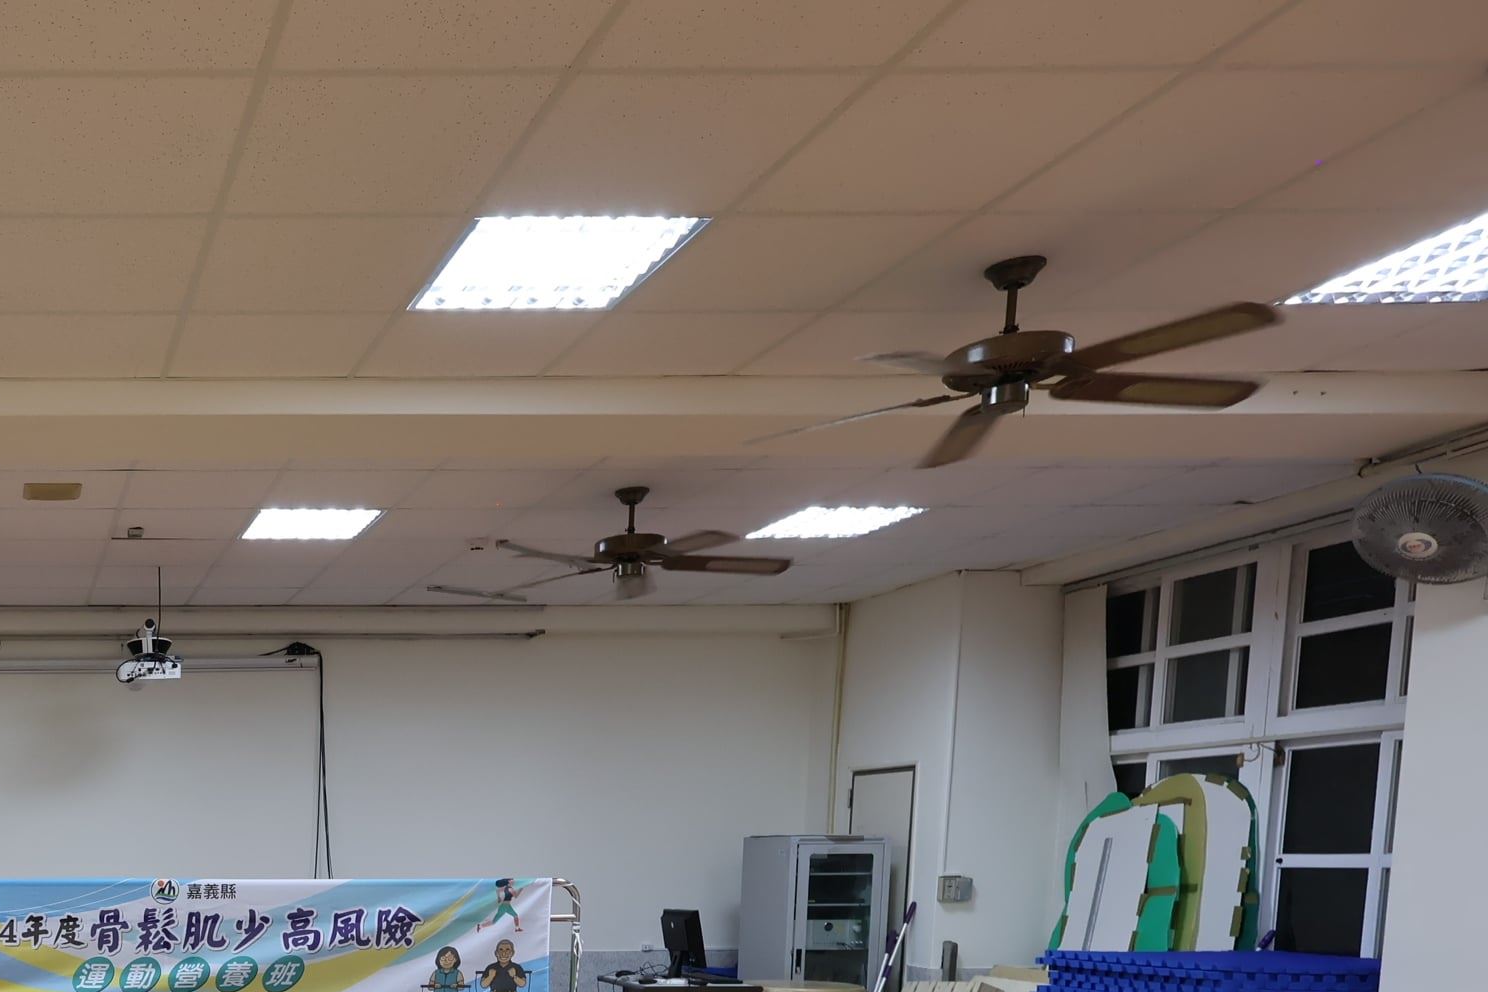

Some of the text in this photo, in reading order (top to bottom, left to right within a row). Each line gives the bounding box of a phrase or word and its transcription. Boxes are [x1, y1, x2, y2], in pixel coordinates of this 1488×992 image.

[185, 883, 238, 901] 嘉義縣
[76, 959, 301, 992] 運動營養班
